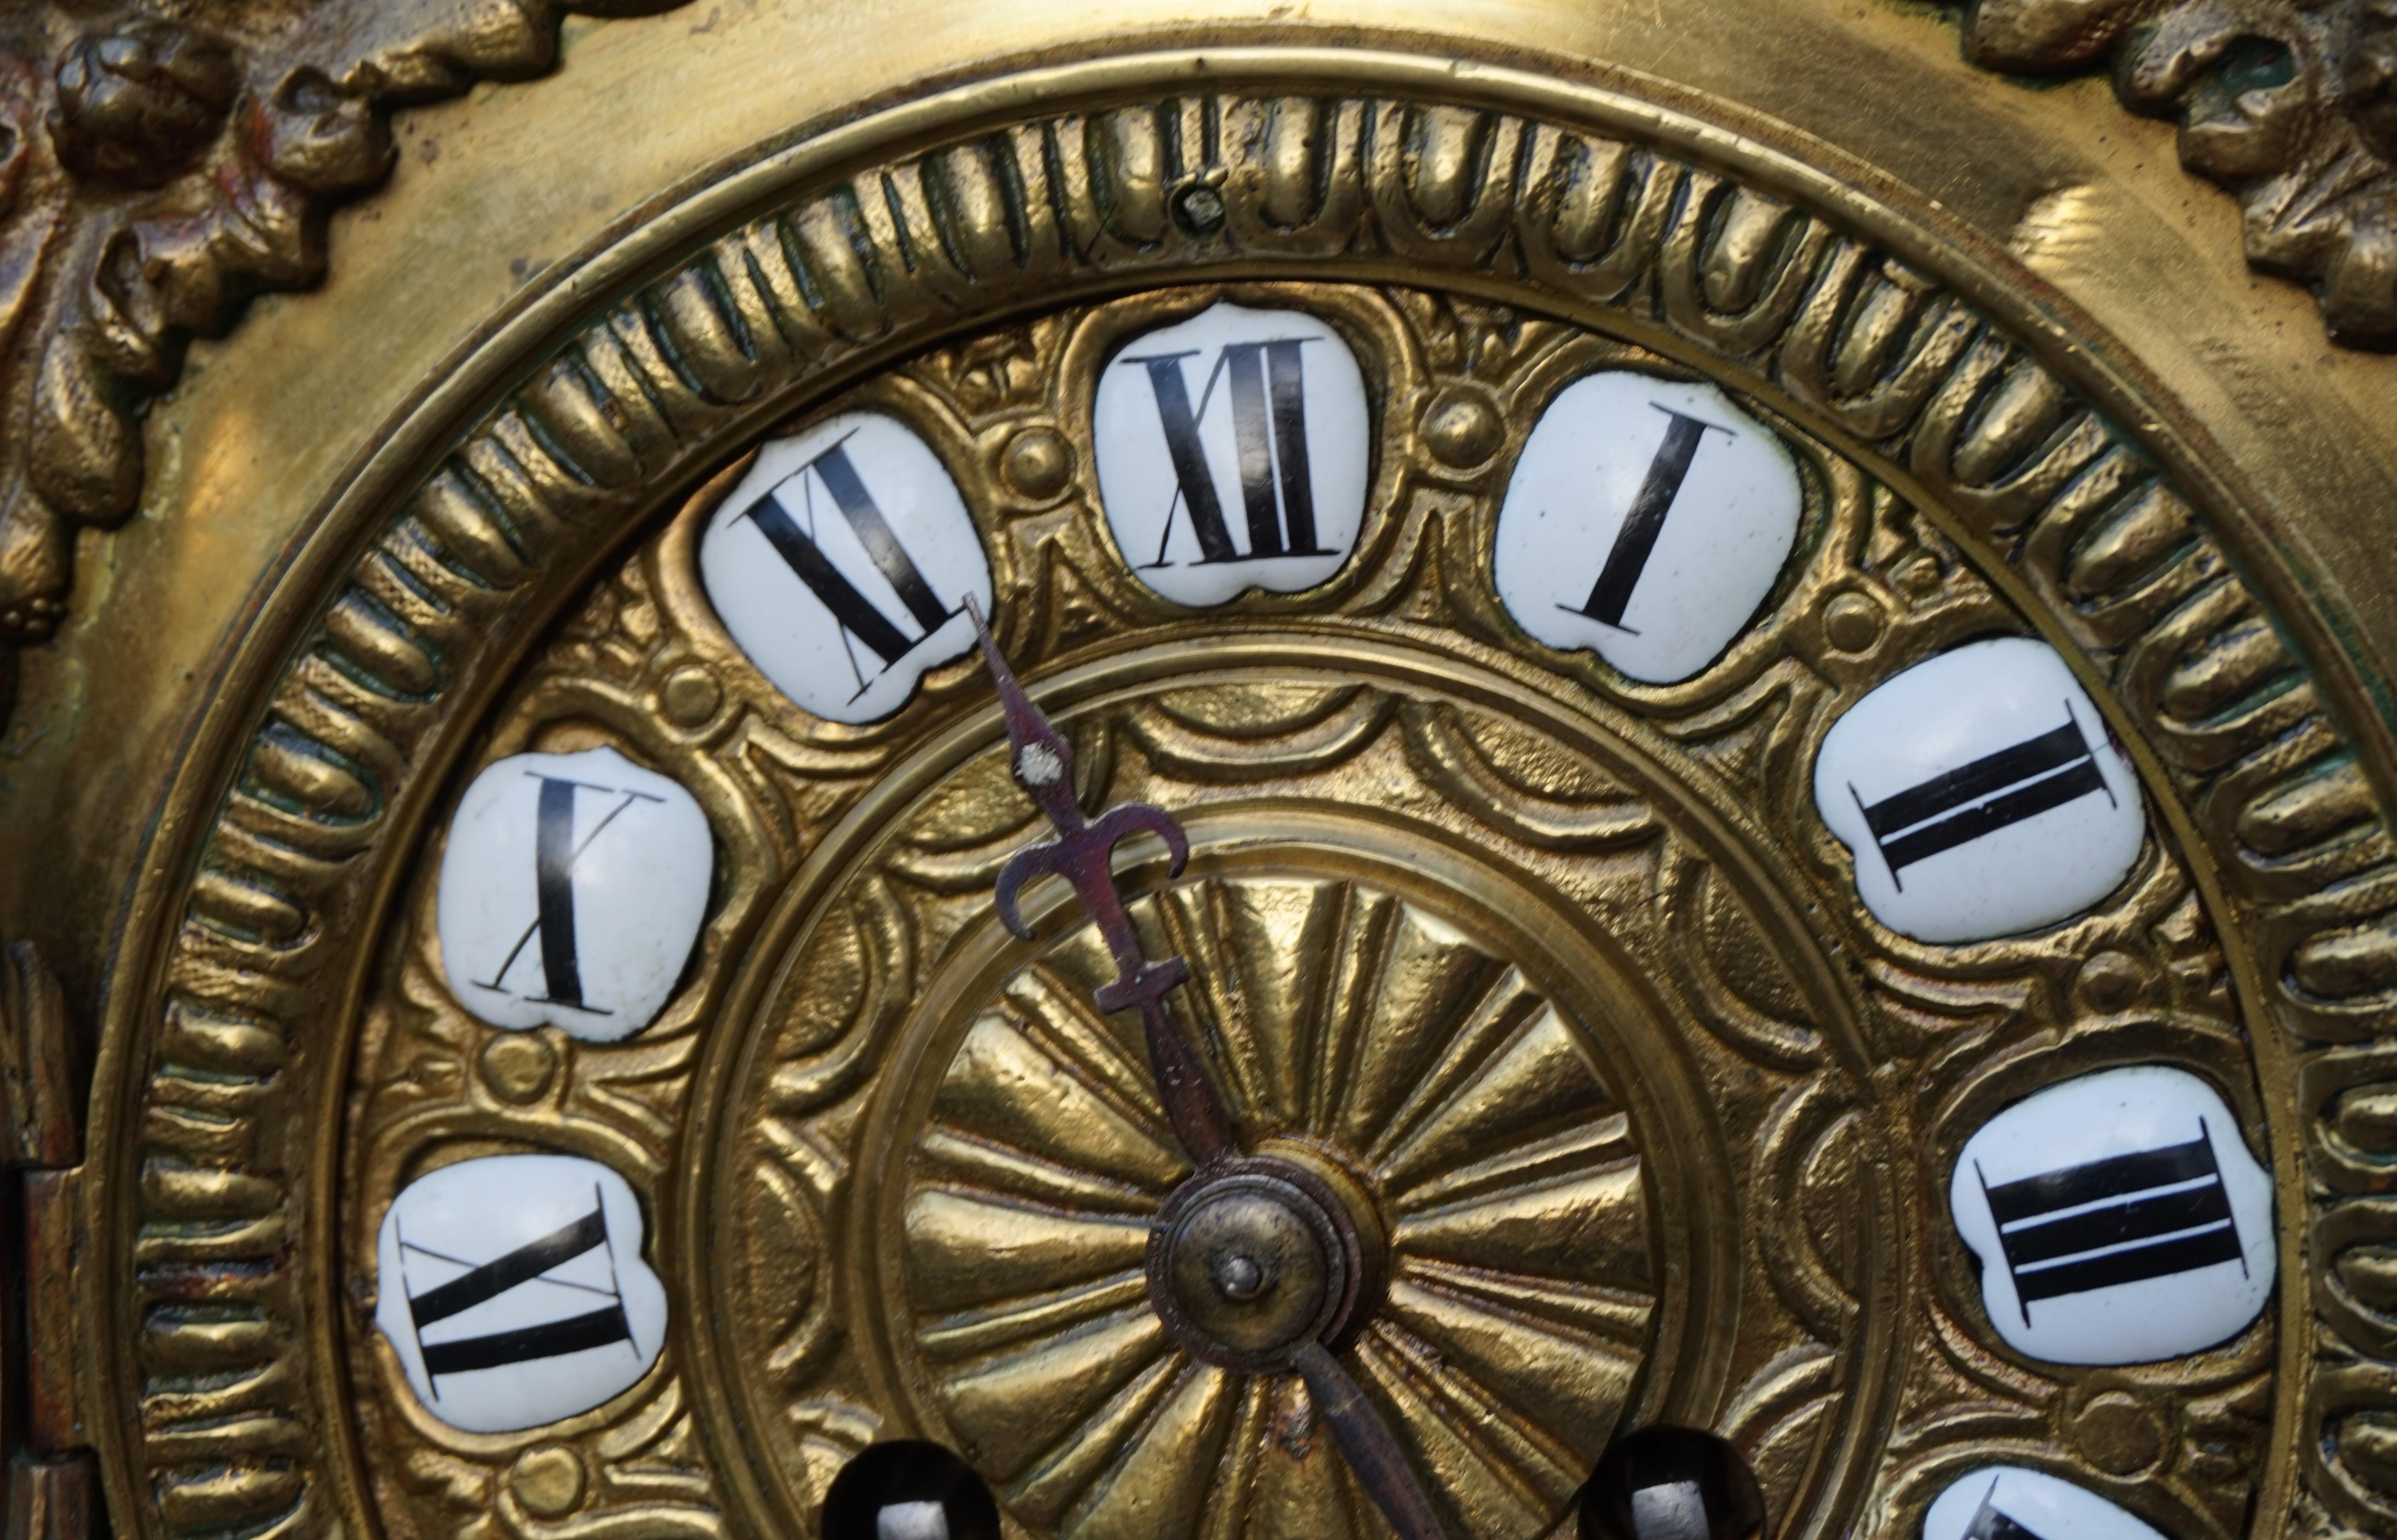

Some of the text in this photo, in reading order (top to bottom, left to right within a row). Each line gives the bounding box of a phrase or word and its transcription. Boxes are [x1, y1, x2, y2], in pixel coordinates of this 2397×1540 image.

[727, 426, 969, 707] XI
[1119, 336, 1342, 571] XII
[1555, 401, 1738, 636] I
[471, 770, 668, 1015] X
[1848, 697, 2117, 893] II
[396, 1181, 641, 1402] IX
[1973, 1115, 2249, 1329] III
